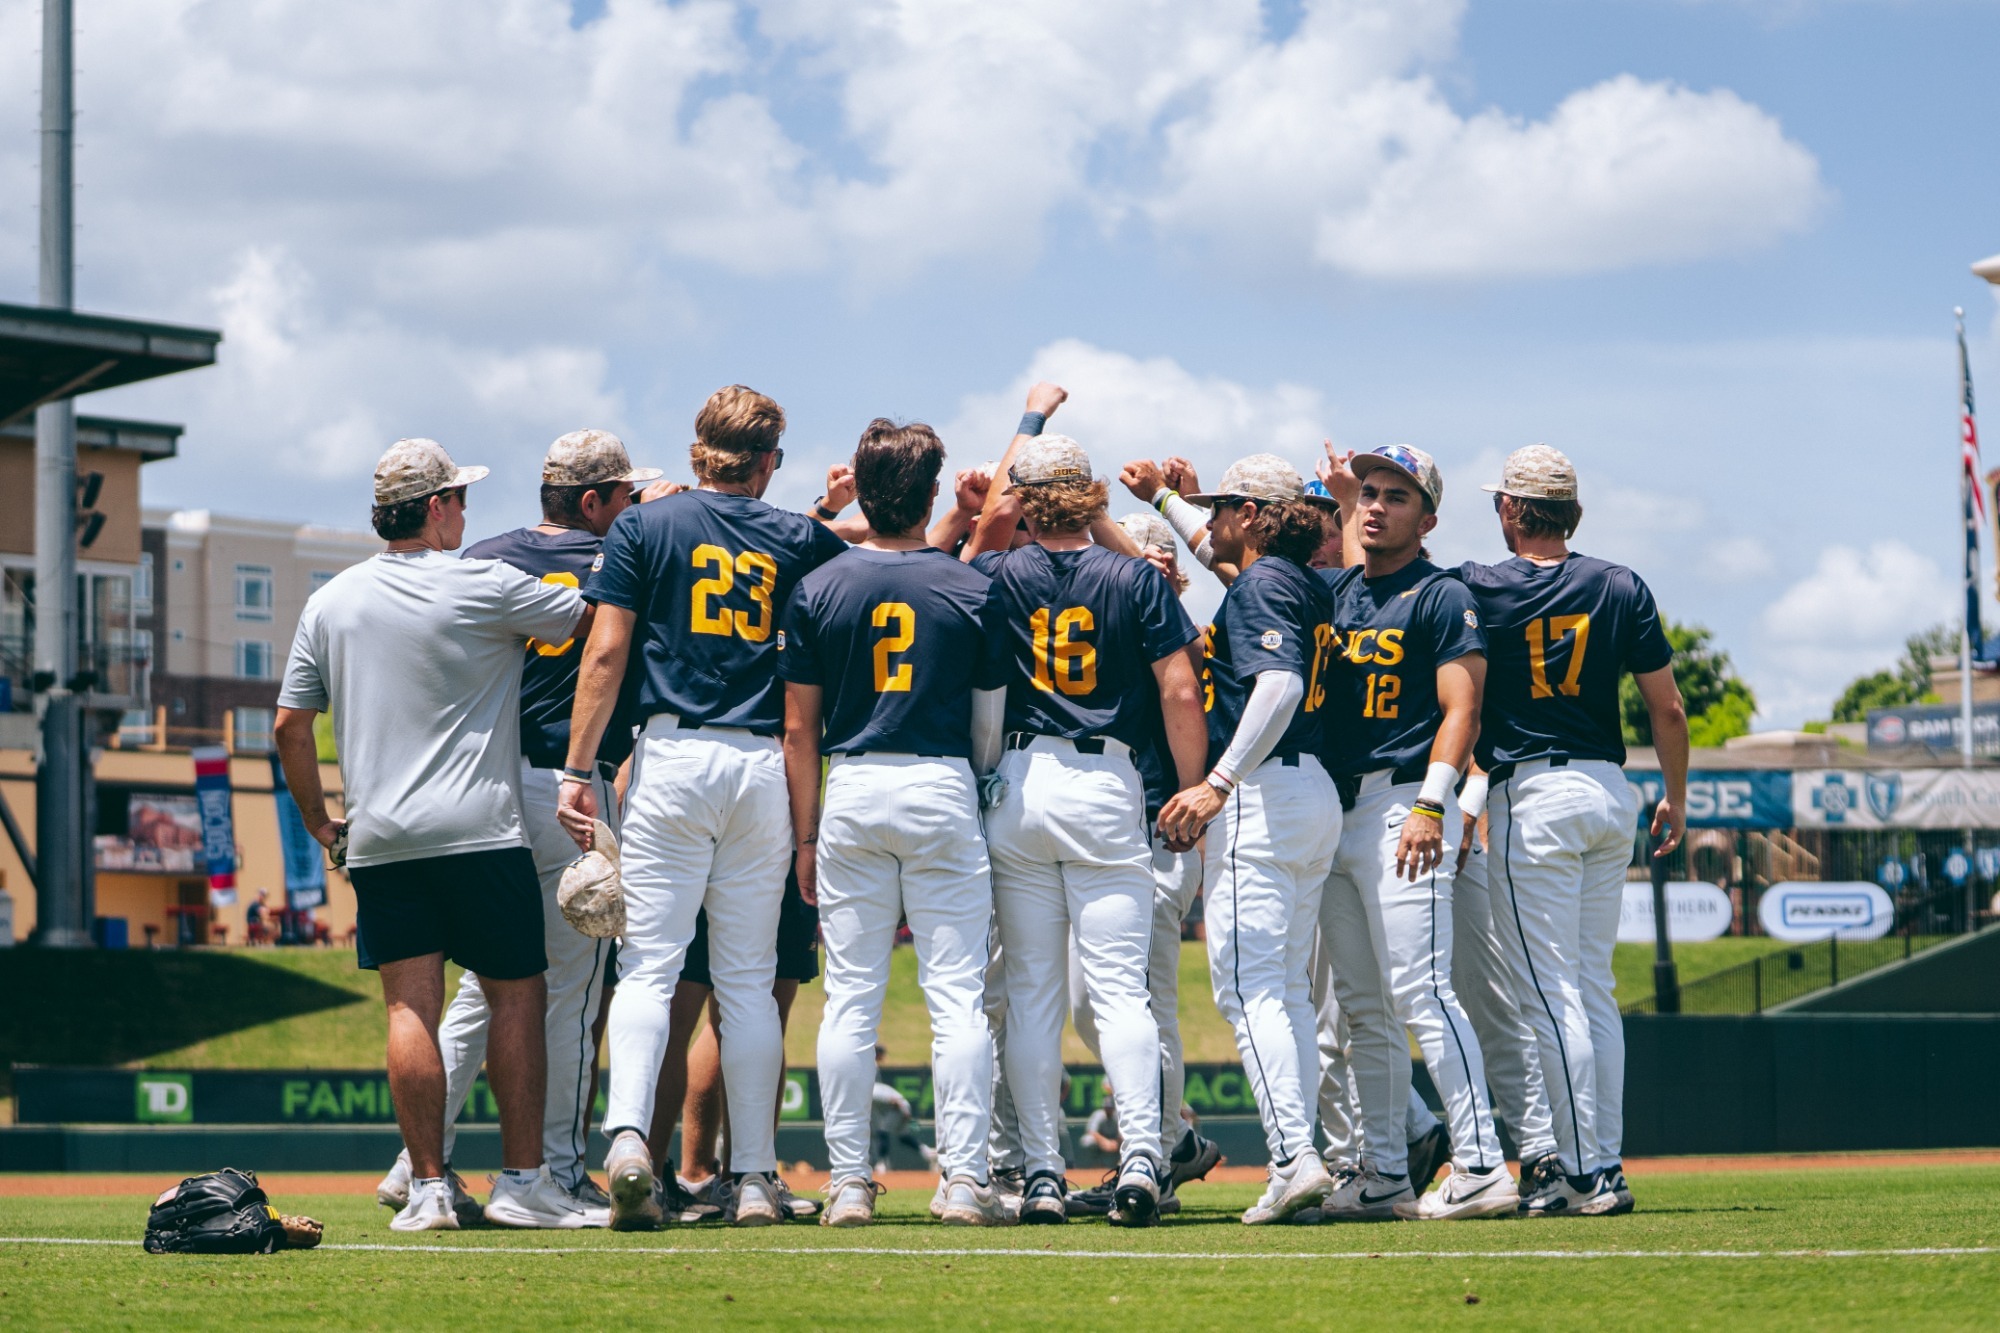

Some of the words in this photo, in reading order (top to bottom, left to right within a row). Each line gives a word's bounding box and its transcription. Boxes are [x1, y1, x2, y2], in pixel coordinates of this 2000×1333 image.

[691, 543, 777, 642] 23
[872, 602, 915, 692] 2
[1030, 606, 1097, 695] 16
[1525, 613, 1590, 699] 17
[1363, 673, 1402, 719] 12
[140, 1081, 188, 1113] TD
